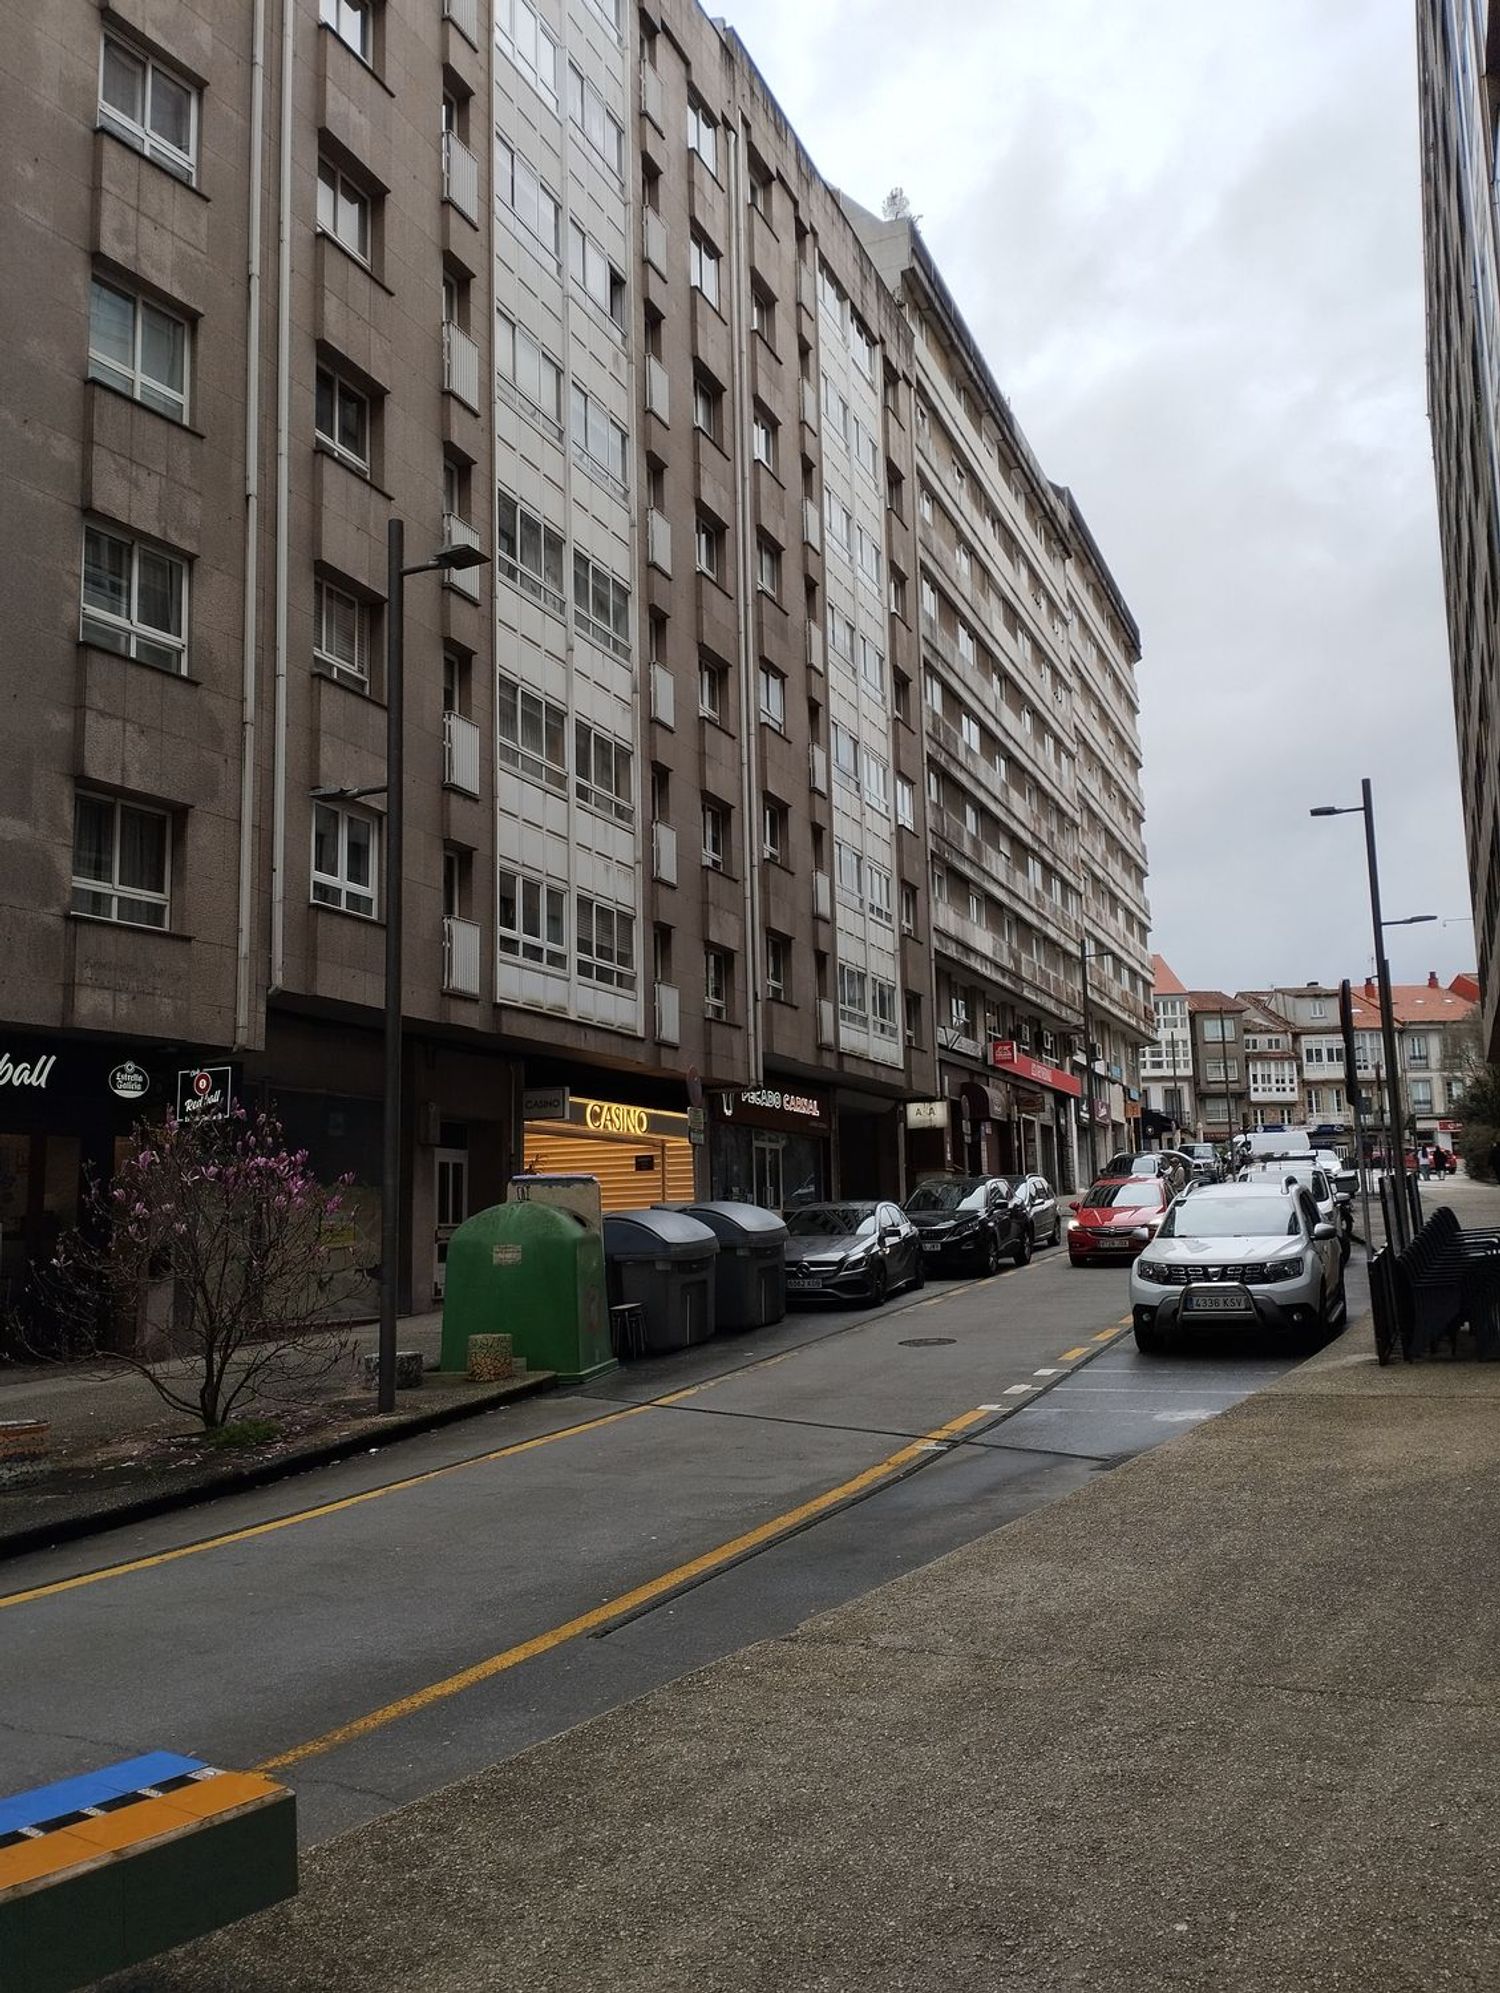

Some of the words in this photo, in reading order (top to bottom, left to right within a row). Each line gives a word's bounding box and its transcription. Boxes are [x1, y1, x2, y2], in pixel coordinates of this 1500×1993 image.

[525, 1097, 561, 1110] CASINO
[586, 1101, 649, 1134] CASINO
[1195, 1297, 1220, 1308] 4336
